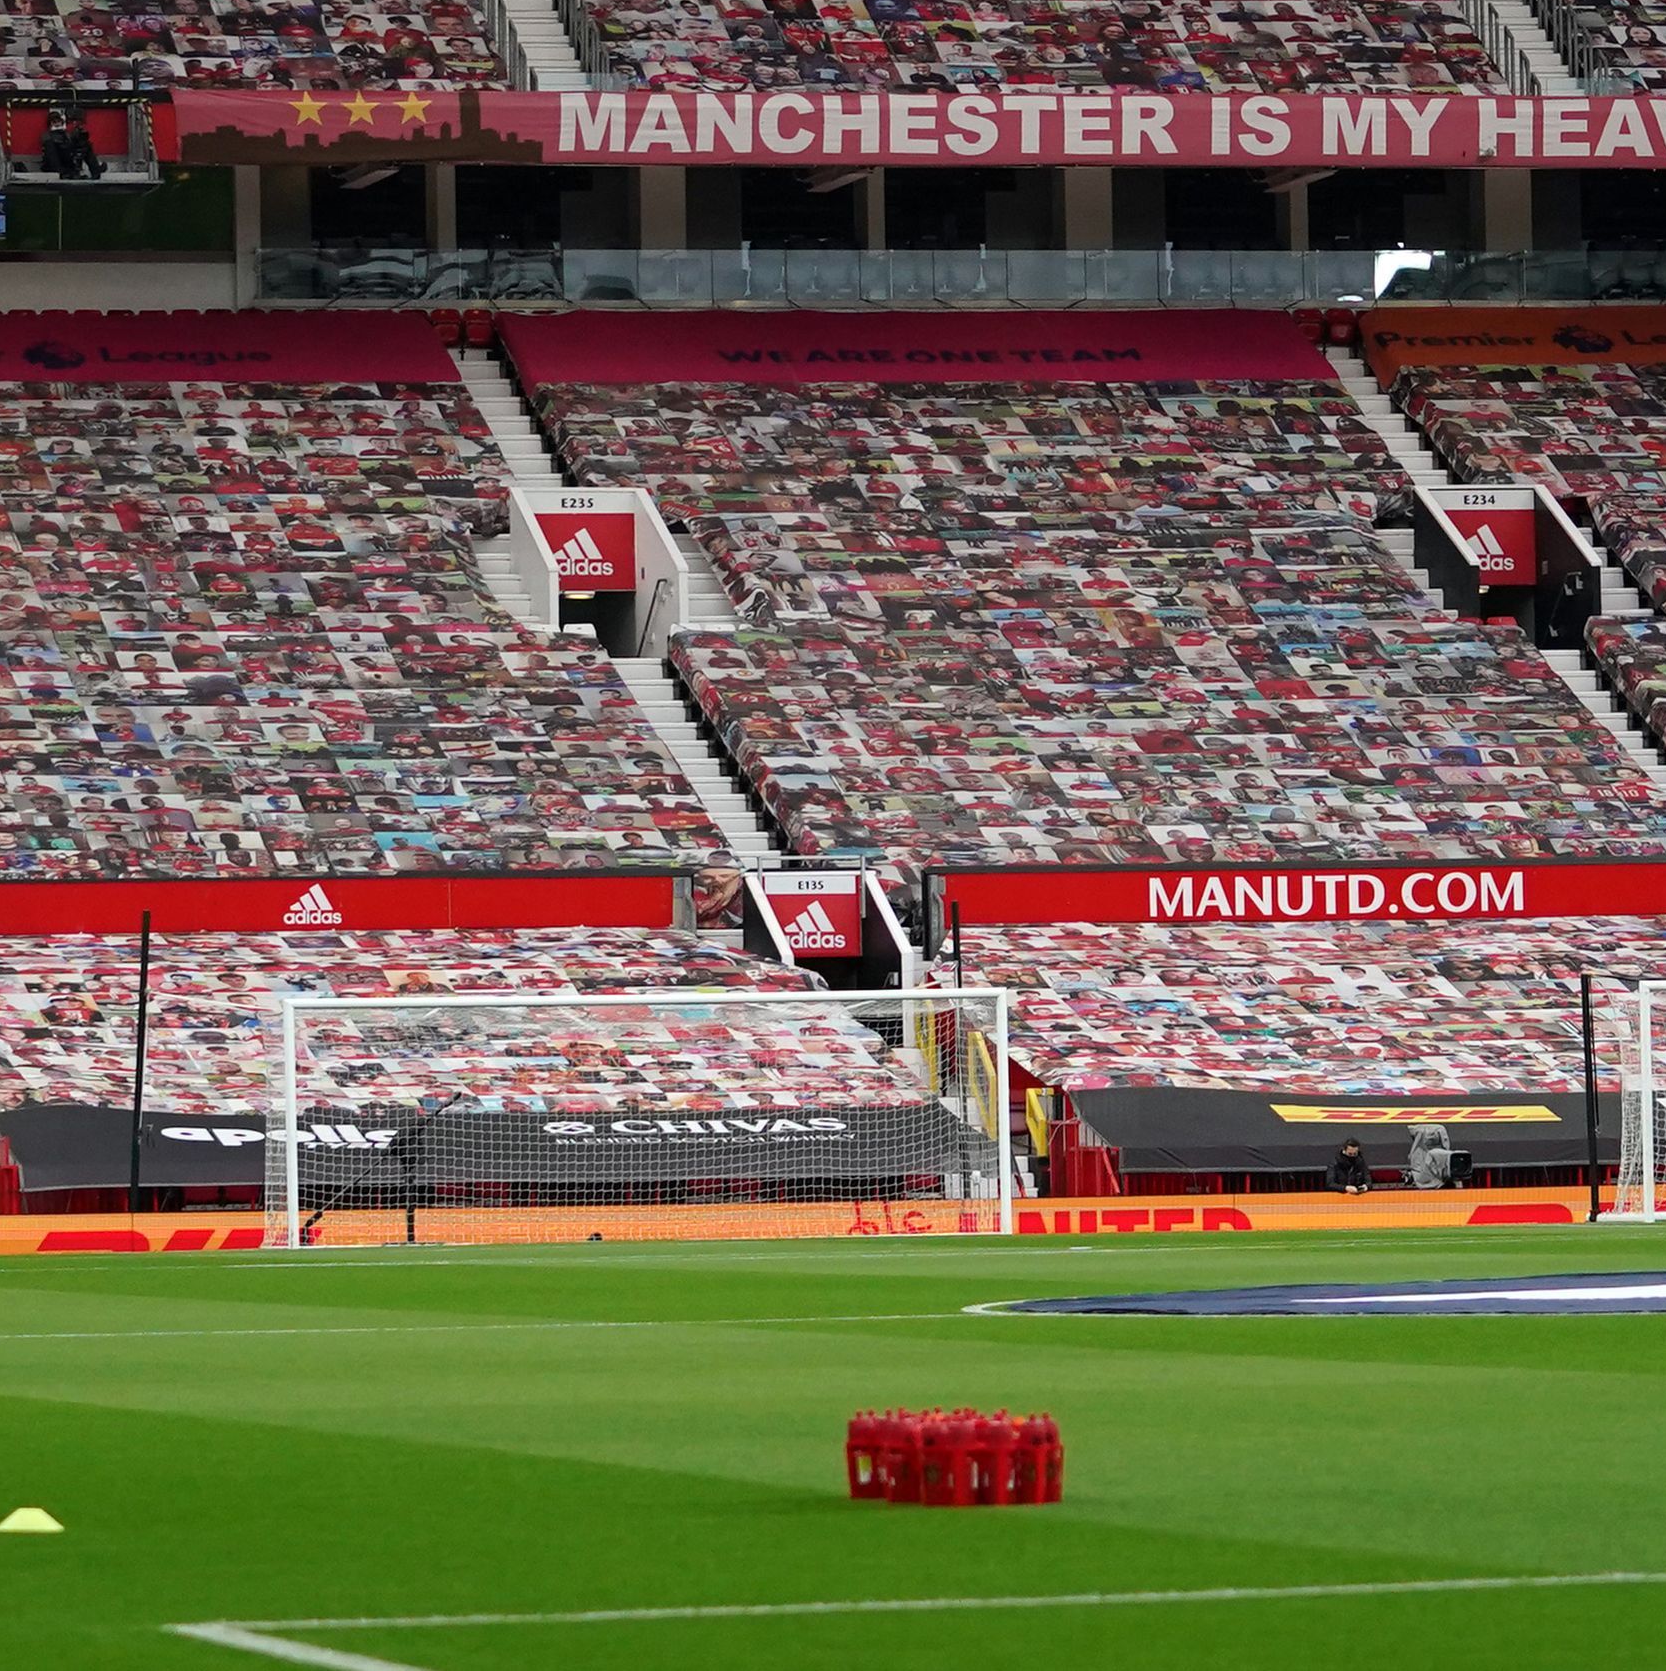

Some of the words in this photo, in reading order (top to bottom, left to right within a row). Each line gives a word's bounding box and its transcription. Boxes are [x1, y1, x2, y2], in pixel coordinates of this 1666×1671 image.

[559, 92, 1176, 155] MANCHESTER
[1211, 96, 1292, 156] IS
[1323, 97, 1450, 156] MY
[1373, 331, 1537, 349] Premier
[99, 346, 272, 366] League
[719, 349, 793, 363] WE
[806, 349, 895, 363] ARE
[905, 349, 1001, 363] ONE
[1008, 348, 1142, 363] TEAM
[562, 498, 594, 508] E235
[1464, 495, 1495, 505] E234
[557, 559, 614, 576] didas
[1148, 871, 1525, 918] MANUTD.COM
[283, 908, 342, 925] adidas
[1319, 1109, 1518, 1120] DHL
[611, 1117, 848, 1134] CHIVAS
